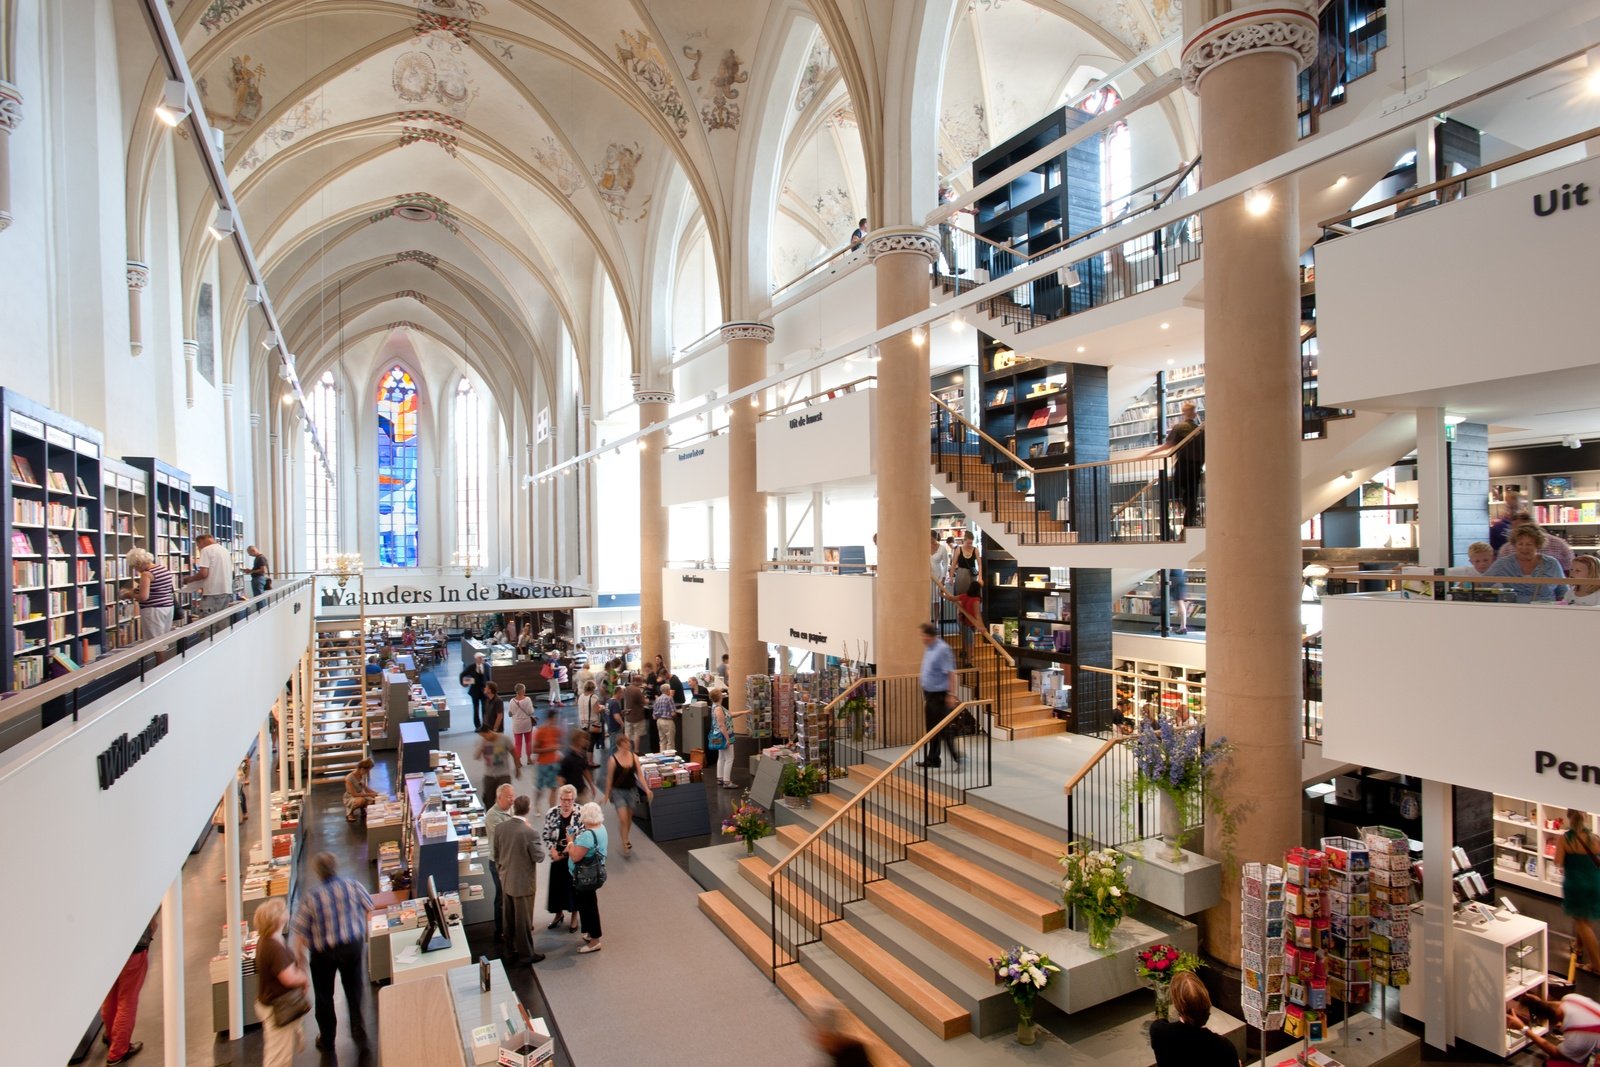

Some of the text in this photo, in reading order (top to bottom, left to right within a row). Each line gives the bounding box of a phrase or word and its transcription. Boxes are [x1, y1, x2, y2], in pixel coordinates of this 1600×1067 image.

[1533, 182, 1589, 217] Uit
[322, 582, 574, 606] Waanders In de Broeren
[789, 627, 800, 638] Pen
[800, 632, 808, 640] en
[1535, 750, 1600, 786] Pen
